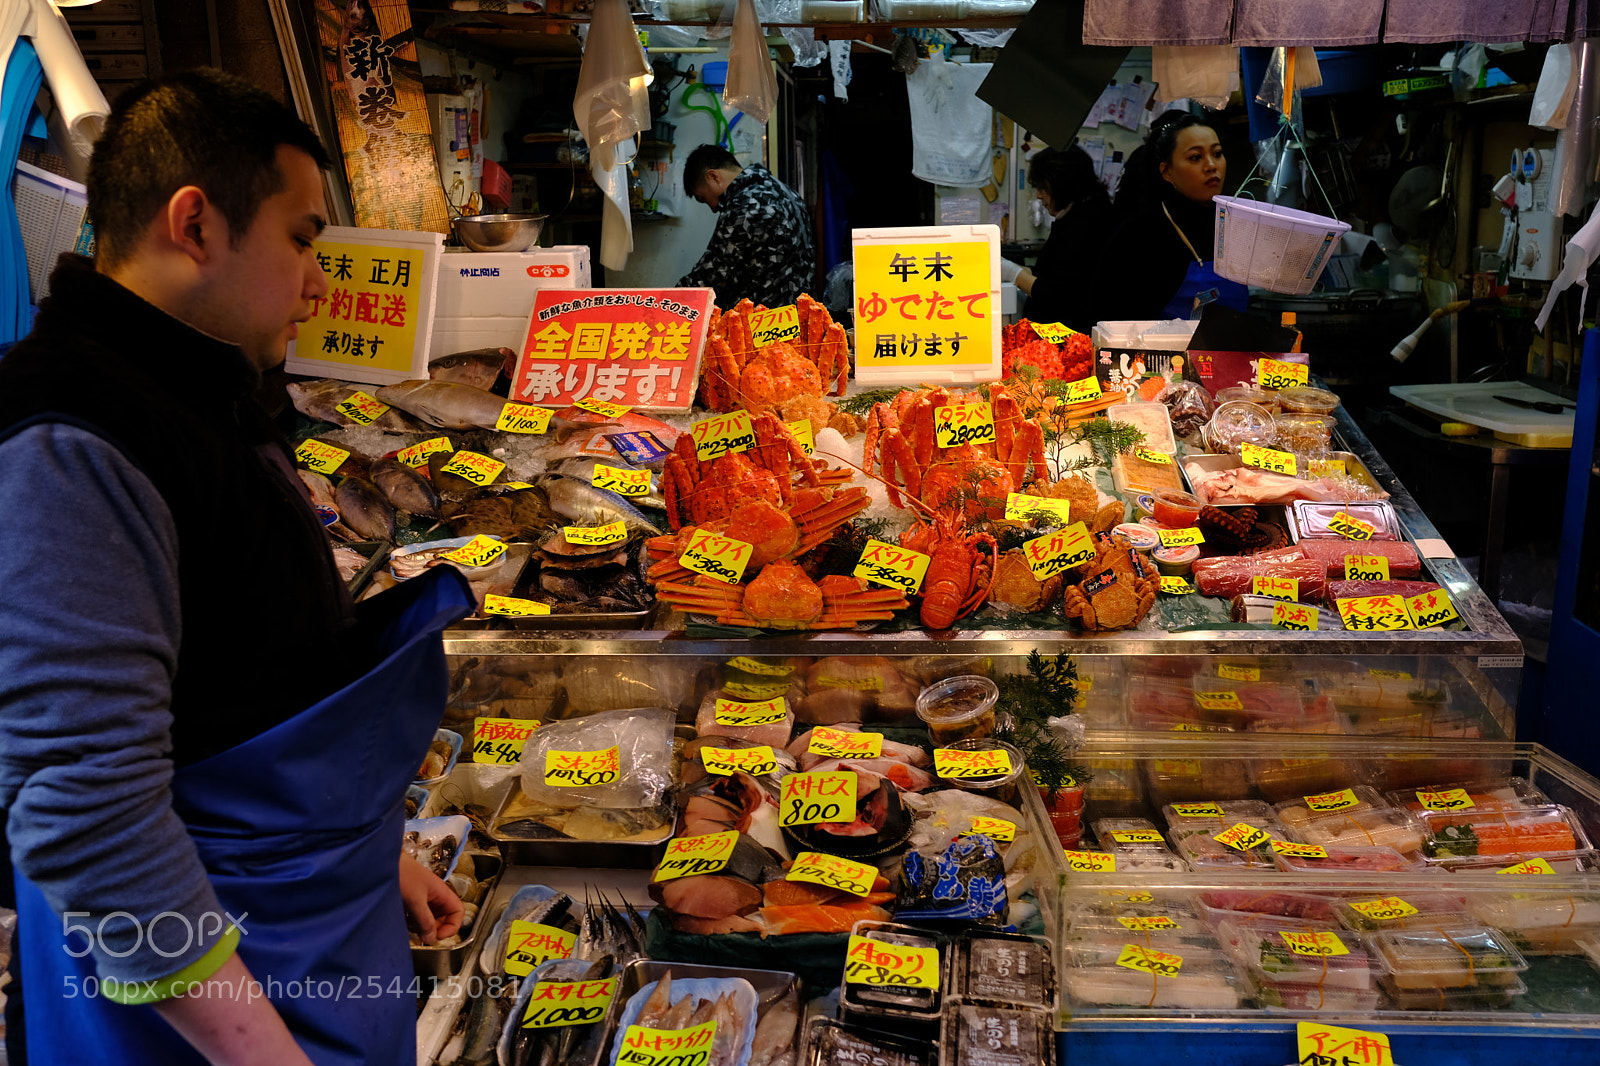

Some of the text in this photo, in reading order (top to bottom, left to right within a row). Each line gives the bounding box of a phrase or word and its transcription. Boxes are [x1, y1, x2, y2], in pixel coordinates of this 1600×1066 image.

[370, 258, 412, 289] 正月
[888, 251, 954, 284] 年末
[858, 290, 989, 323] ゆでたて
[749, 305, 798, 334] タラバ
[321, 330, 385, 360] 承ります
[529, 321, 692, 362] 全国発送
[873, 332, 969, 360] 届けます
[1262, 359, 1307, 378] 数の子
[938, 402, 989, 425] タラバ
[692, 411, 748, 443] タラバ
[455, 452, 503, 473] かわはぎ
[1010, 493, 1061, 511] 毛ガニ
[690, 534, 749, 562] ズワイ
[1028, 530, 1087, 562] 毛ガニ
[863, 544, 920, 572] ズワイ
[1349, 556, 1380, 567] 中トロ
[1256, 578, 1294, 591] 中トロ
[1348, 567, 1384, 581] 8000
[1275, 604, 1312, 623] かつお
[1337, 594, 1404, 616] 天然
[1344, 613, 1410, 630] 本まぐろ
[1417, 608, 1451, 627] 4000
[555, 754, 607, 770] さわら
[708, 749, 764, 764] さわら
[783, 798, 840, 826] 800
[666, 834, 731, 856] 天然ブリ
[849, 940, 926, 975] 生のり
